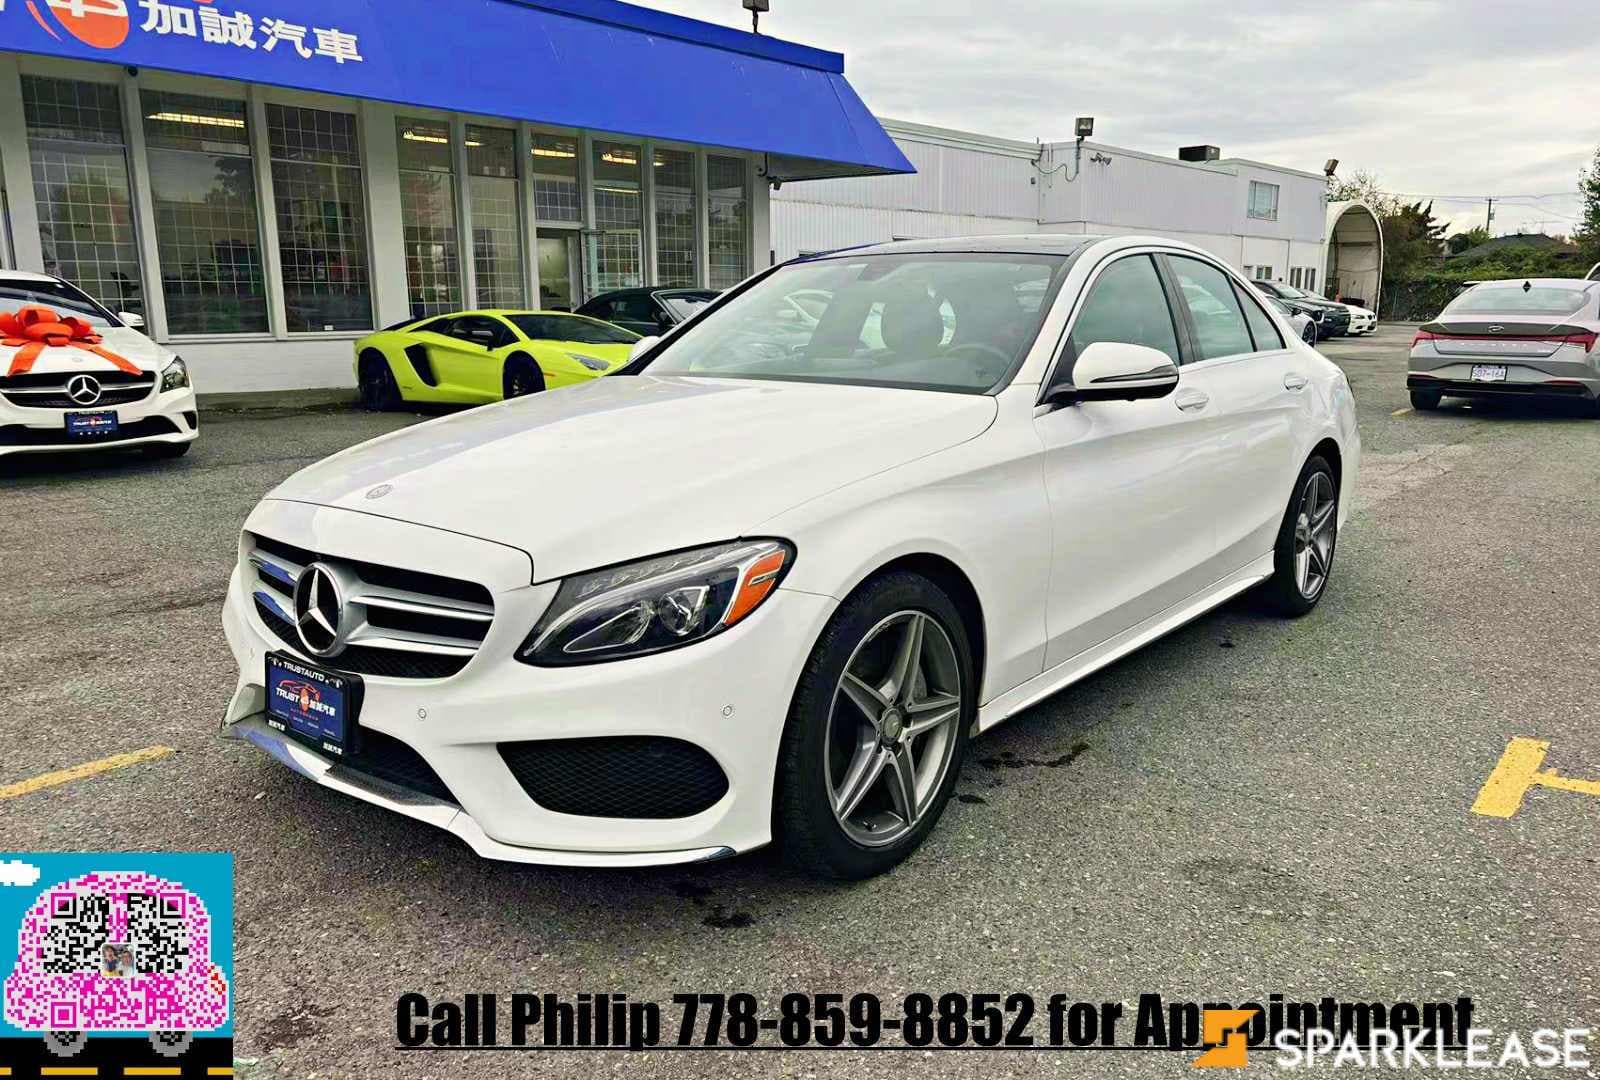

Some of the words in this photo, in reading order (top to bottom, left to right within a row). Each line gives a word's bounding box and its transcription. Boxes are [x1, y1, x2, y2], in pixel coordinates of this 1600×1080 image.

[139, 0, 364, 64] 加誠汽車
[284, 662, 325, 682] TRUSTAUTO
[275, 687, 300, 703] TRUST
